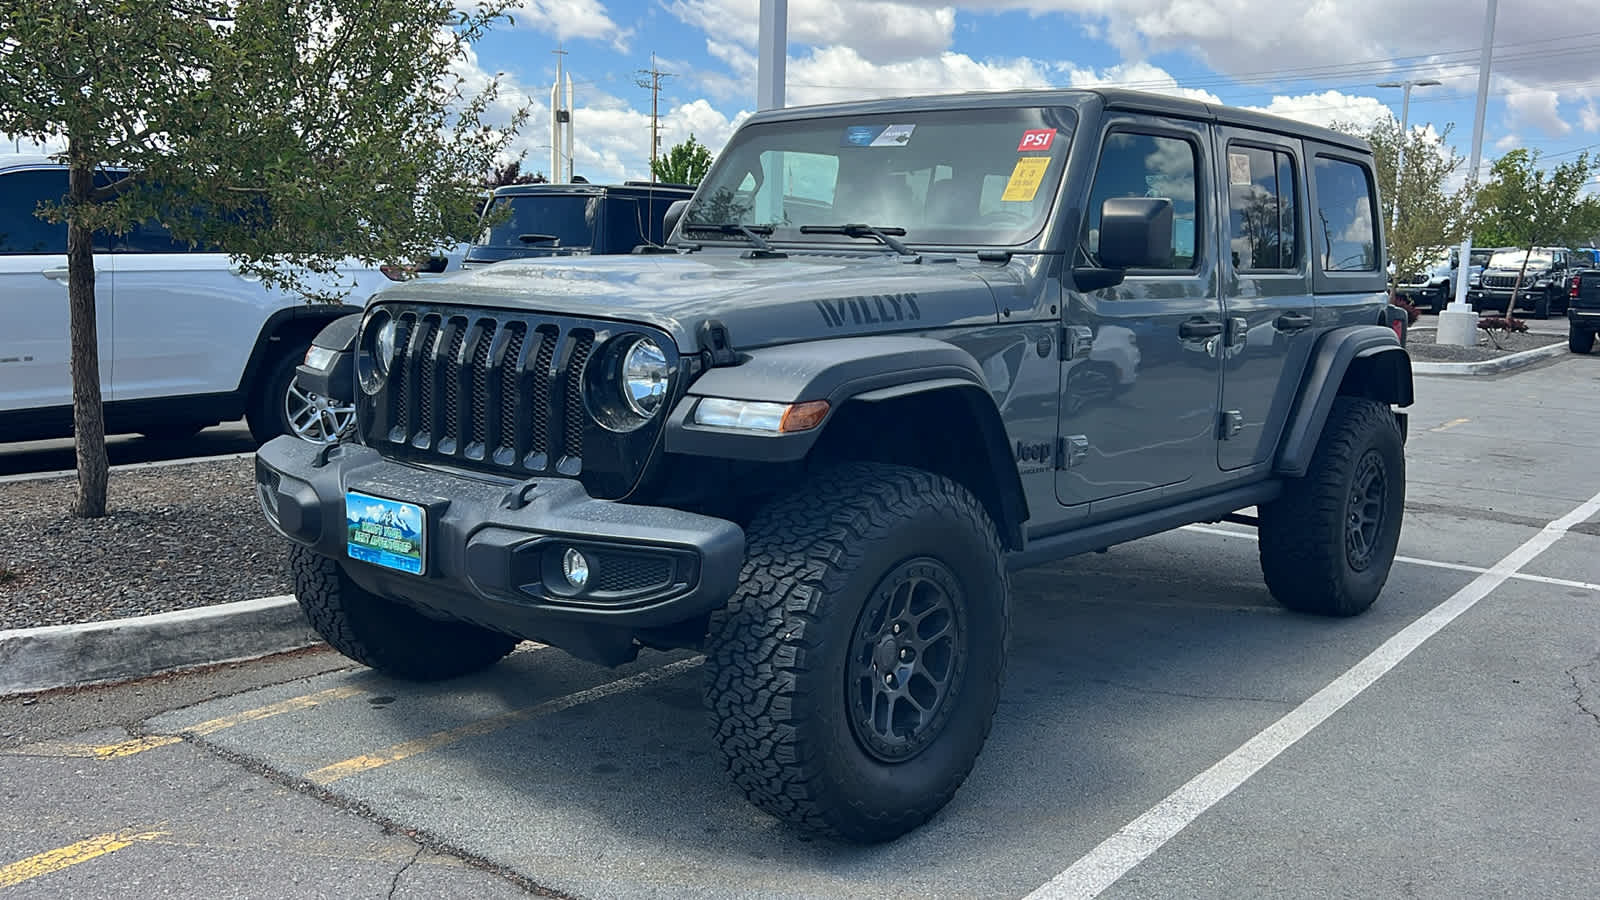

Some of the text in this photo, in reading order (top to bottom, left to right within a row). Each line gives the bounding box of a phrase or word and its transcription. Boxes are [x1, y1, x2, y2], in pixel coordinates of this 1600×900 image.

[1022, 133, 1051, 146] PSI
[814, 293, 921, 328] WILLYS
[1016, 440, 1050, 464] Jeep
